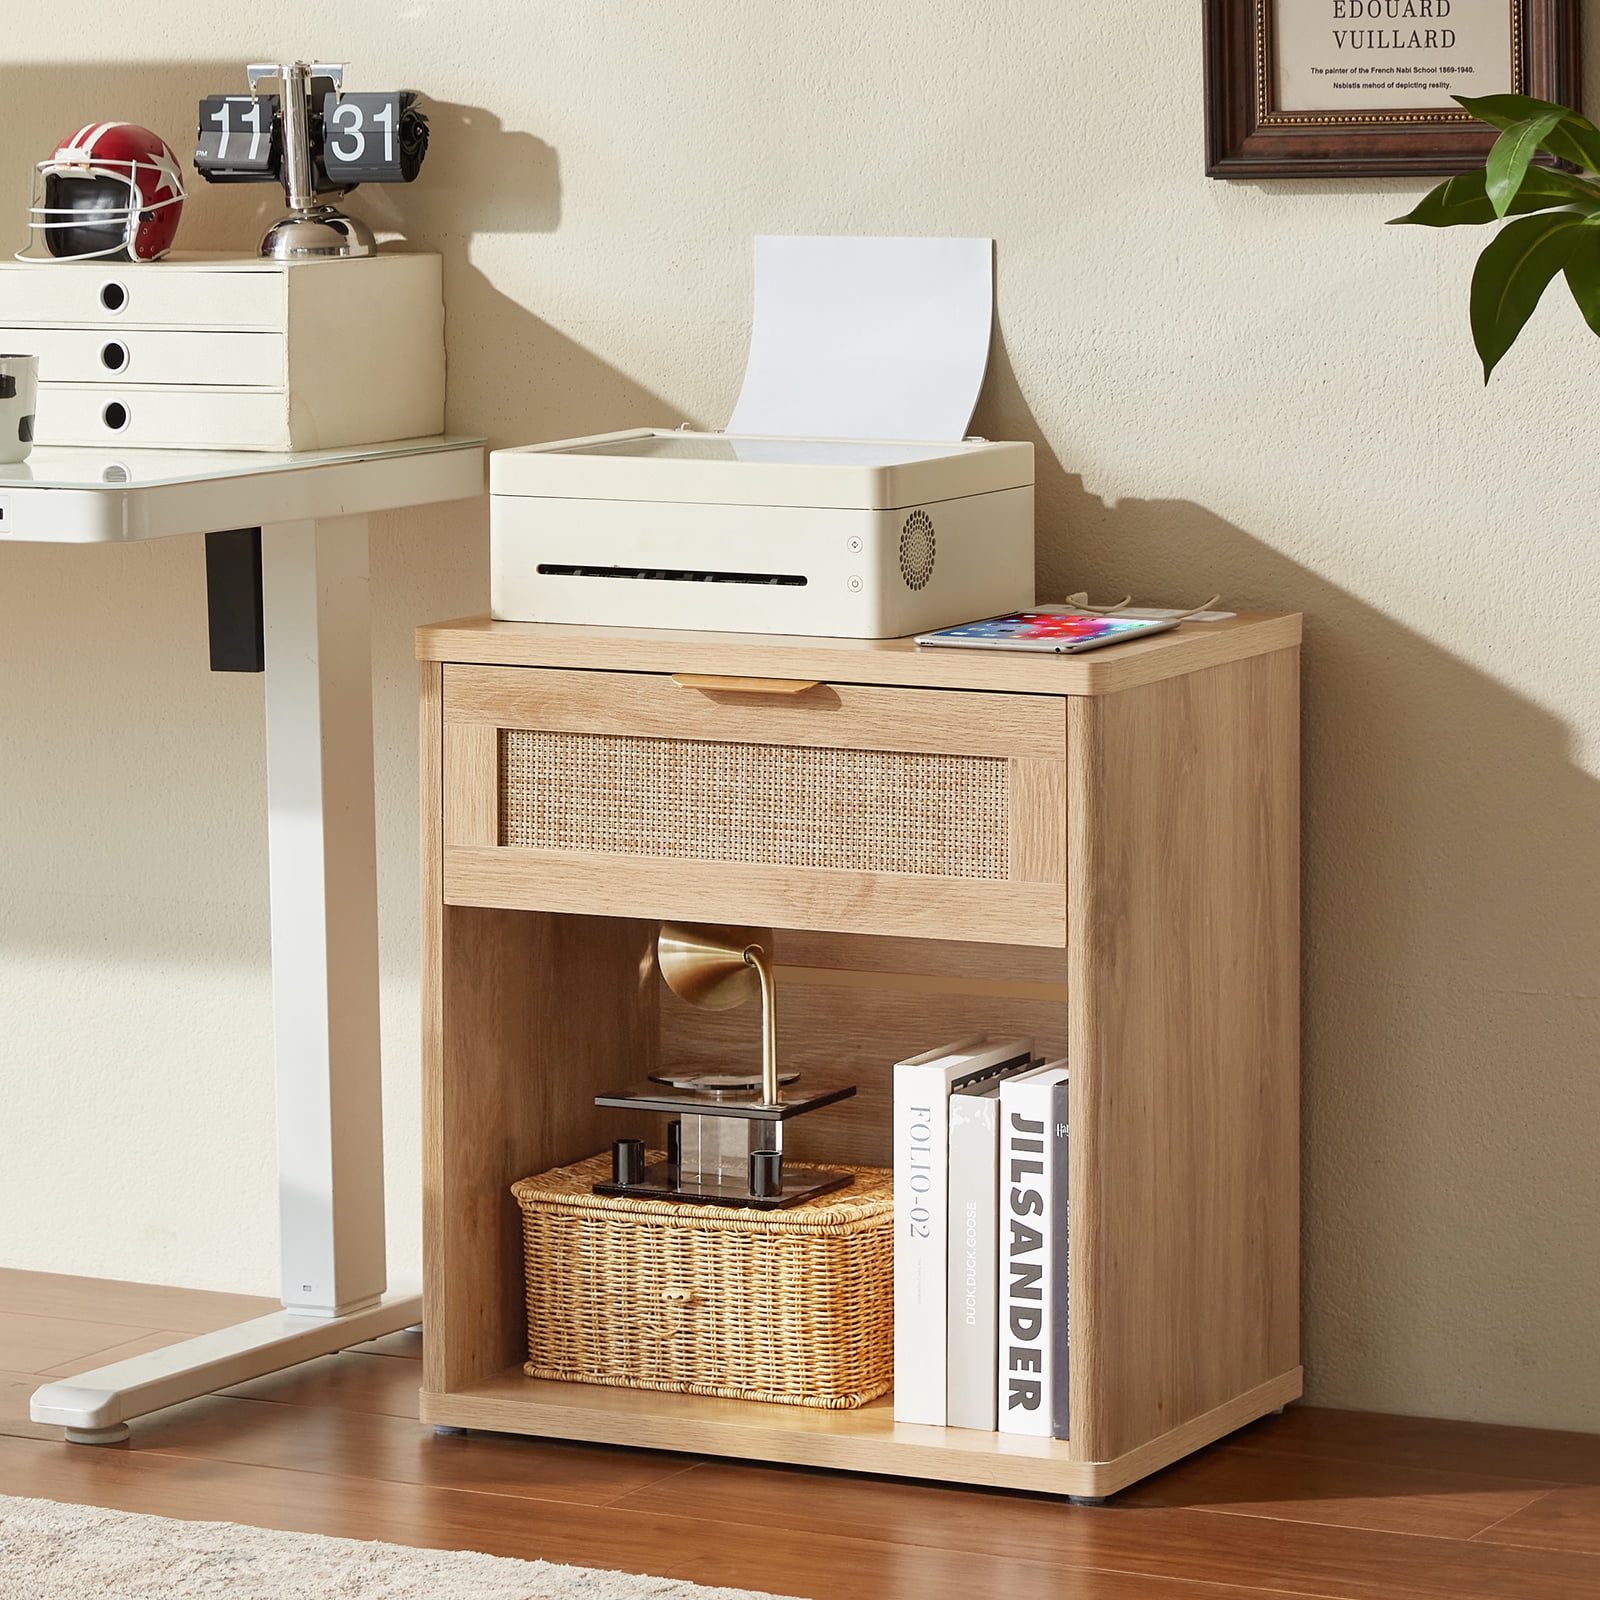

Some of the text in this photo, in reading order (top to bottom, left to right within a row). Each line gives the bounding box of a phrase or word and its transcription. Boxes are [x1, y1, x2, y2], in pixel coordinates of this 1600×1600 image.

[1333, 0, 1450, 18] EDOUARD
[1332, 29, 1456, 49] VUILLARD
[1325, 67, 1348, 75] painter
[1395, 82, 1427, 90] depicting
[210, 103, 260, 159] 11
[331, 103, 393, 162] 31
[195, 150, 208, 158] PM
[910, 1106, 931, 1238] FOLIO-02
